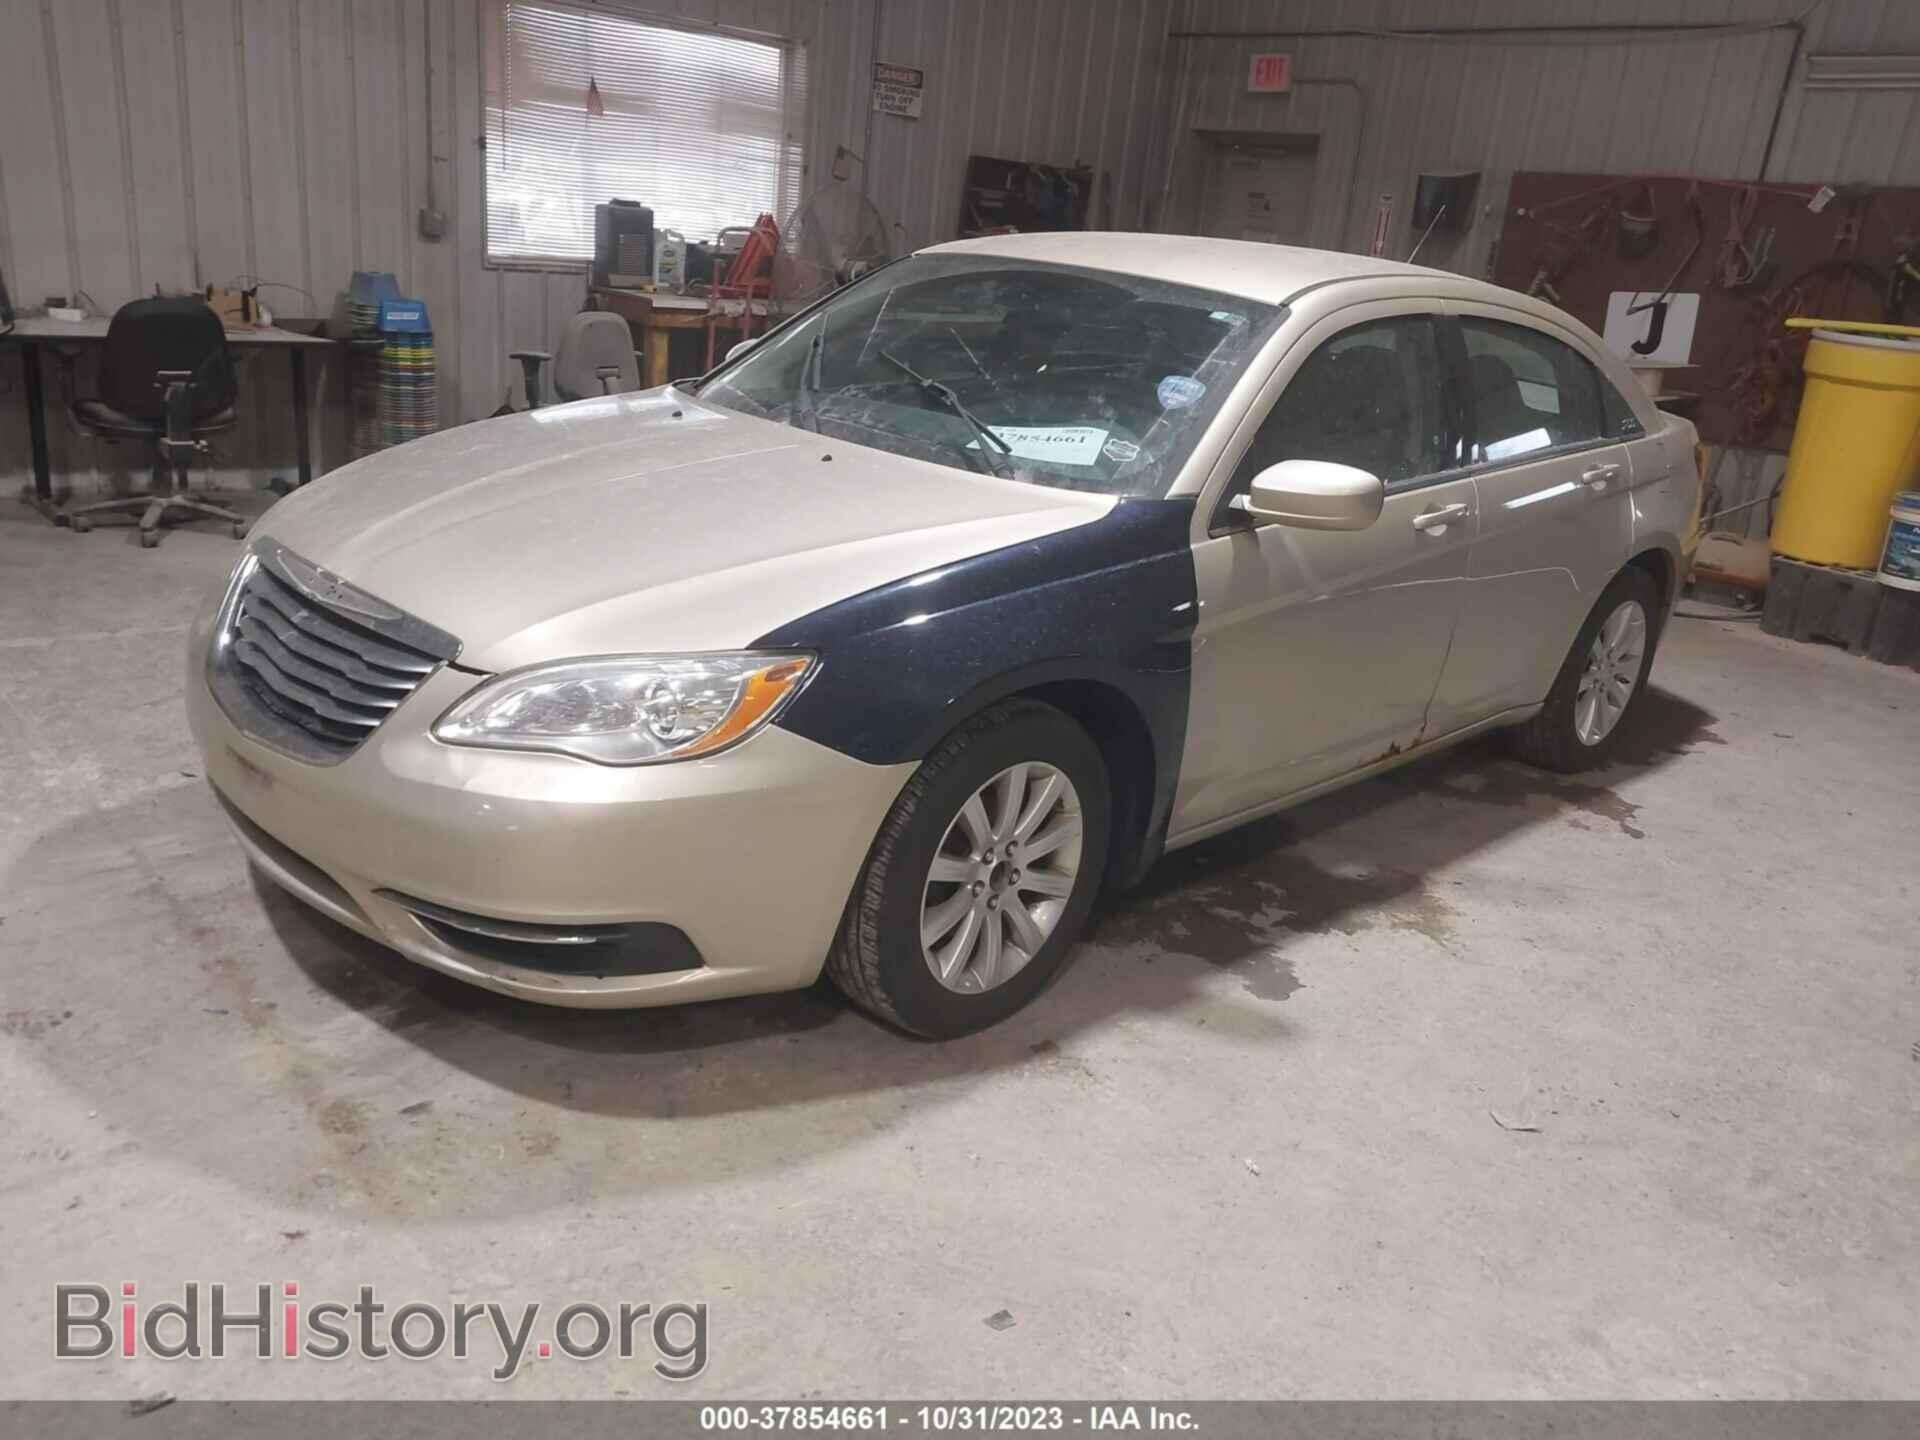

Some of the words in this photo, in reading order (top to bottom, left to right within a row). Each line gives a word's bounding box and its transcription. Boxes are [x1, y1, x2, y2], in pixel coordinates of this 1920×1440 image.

[1255, 57, 1286, 88] EXIT
[876, 92, 896, 103] TURN
[898, 95, 914, 105] OFF
